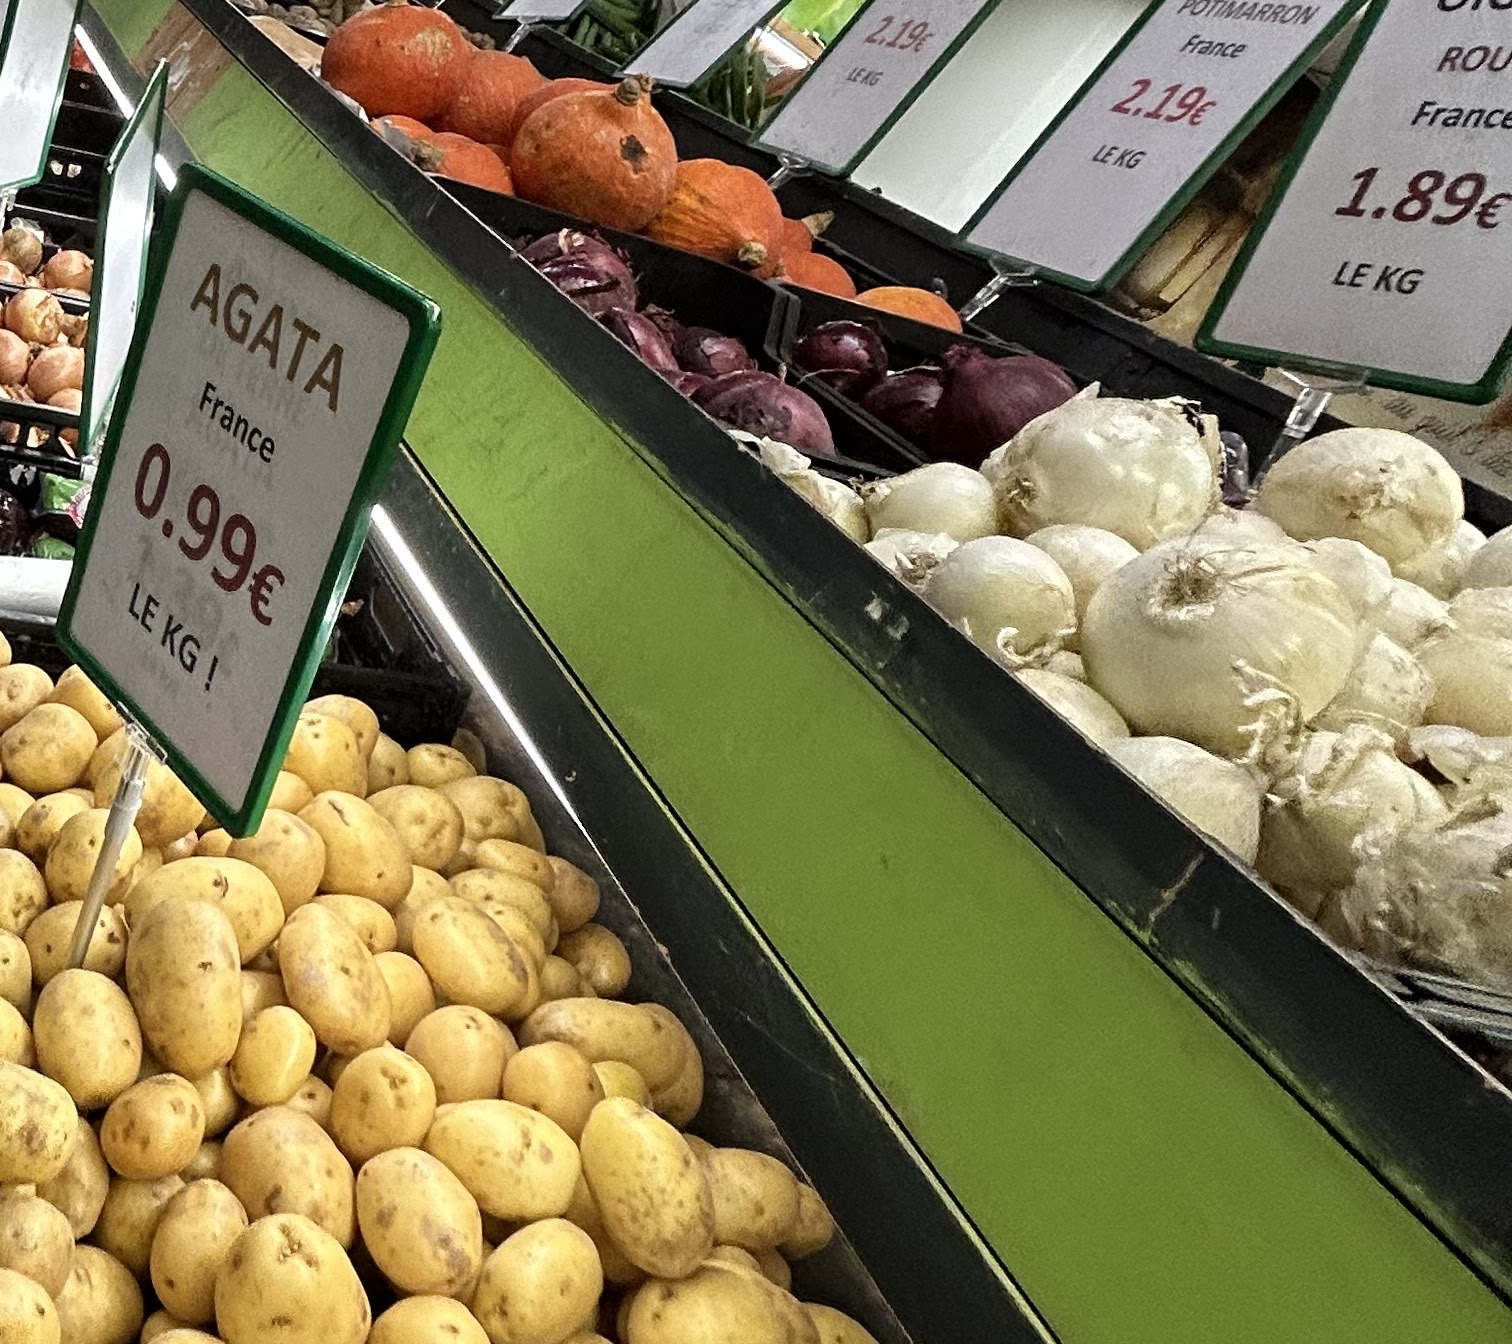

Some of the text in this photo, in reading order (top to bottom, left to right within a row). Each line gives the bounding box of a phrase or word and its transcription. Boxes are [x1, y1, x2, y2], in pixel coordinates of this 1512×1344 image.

[864, 15, 935, 52] 2.19€
[1179, 34, 1248, 58] France
[846, 67, 884, 86] LE KG
[1109, 78, 1217, 126] 2.19€
[1410, 100, 1512, 129] France
[1092, 144, 1147, 169] LE KG
[1335, 167, 1512, 229] 1.89€
[1333, 261, 1426, 294] LE KG
[190, 263, 345, 414] AGATA
[199, 381, 275, 463] France
[134, 443, 285, 626] 0.99€
[128, 582, 219, 693] LE KG !
